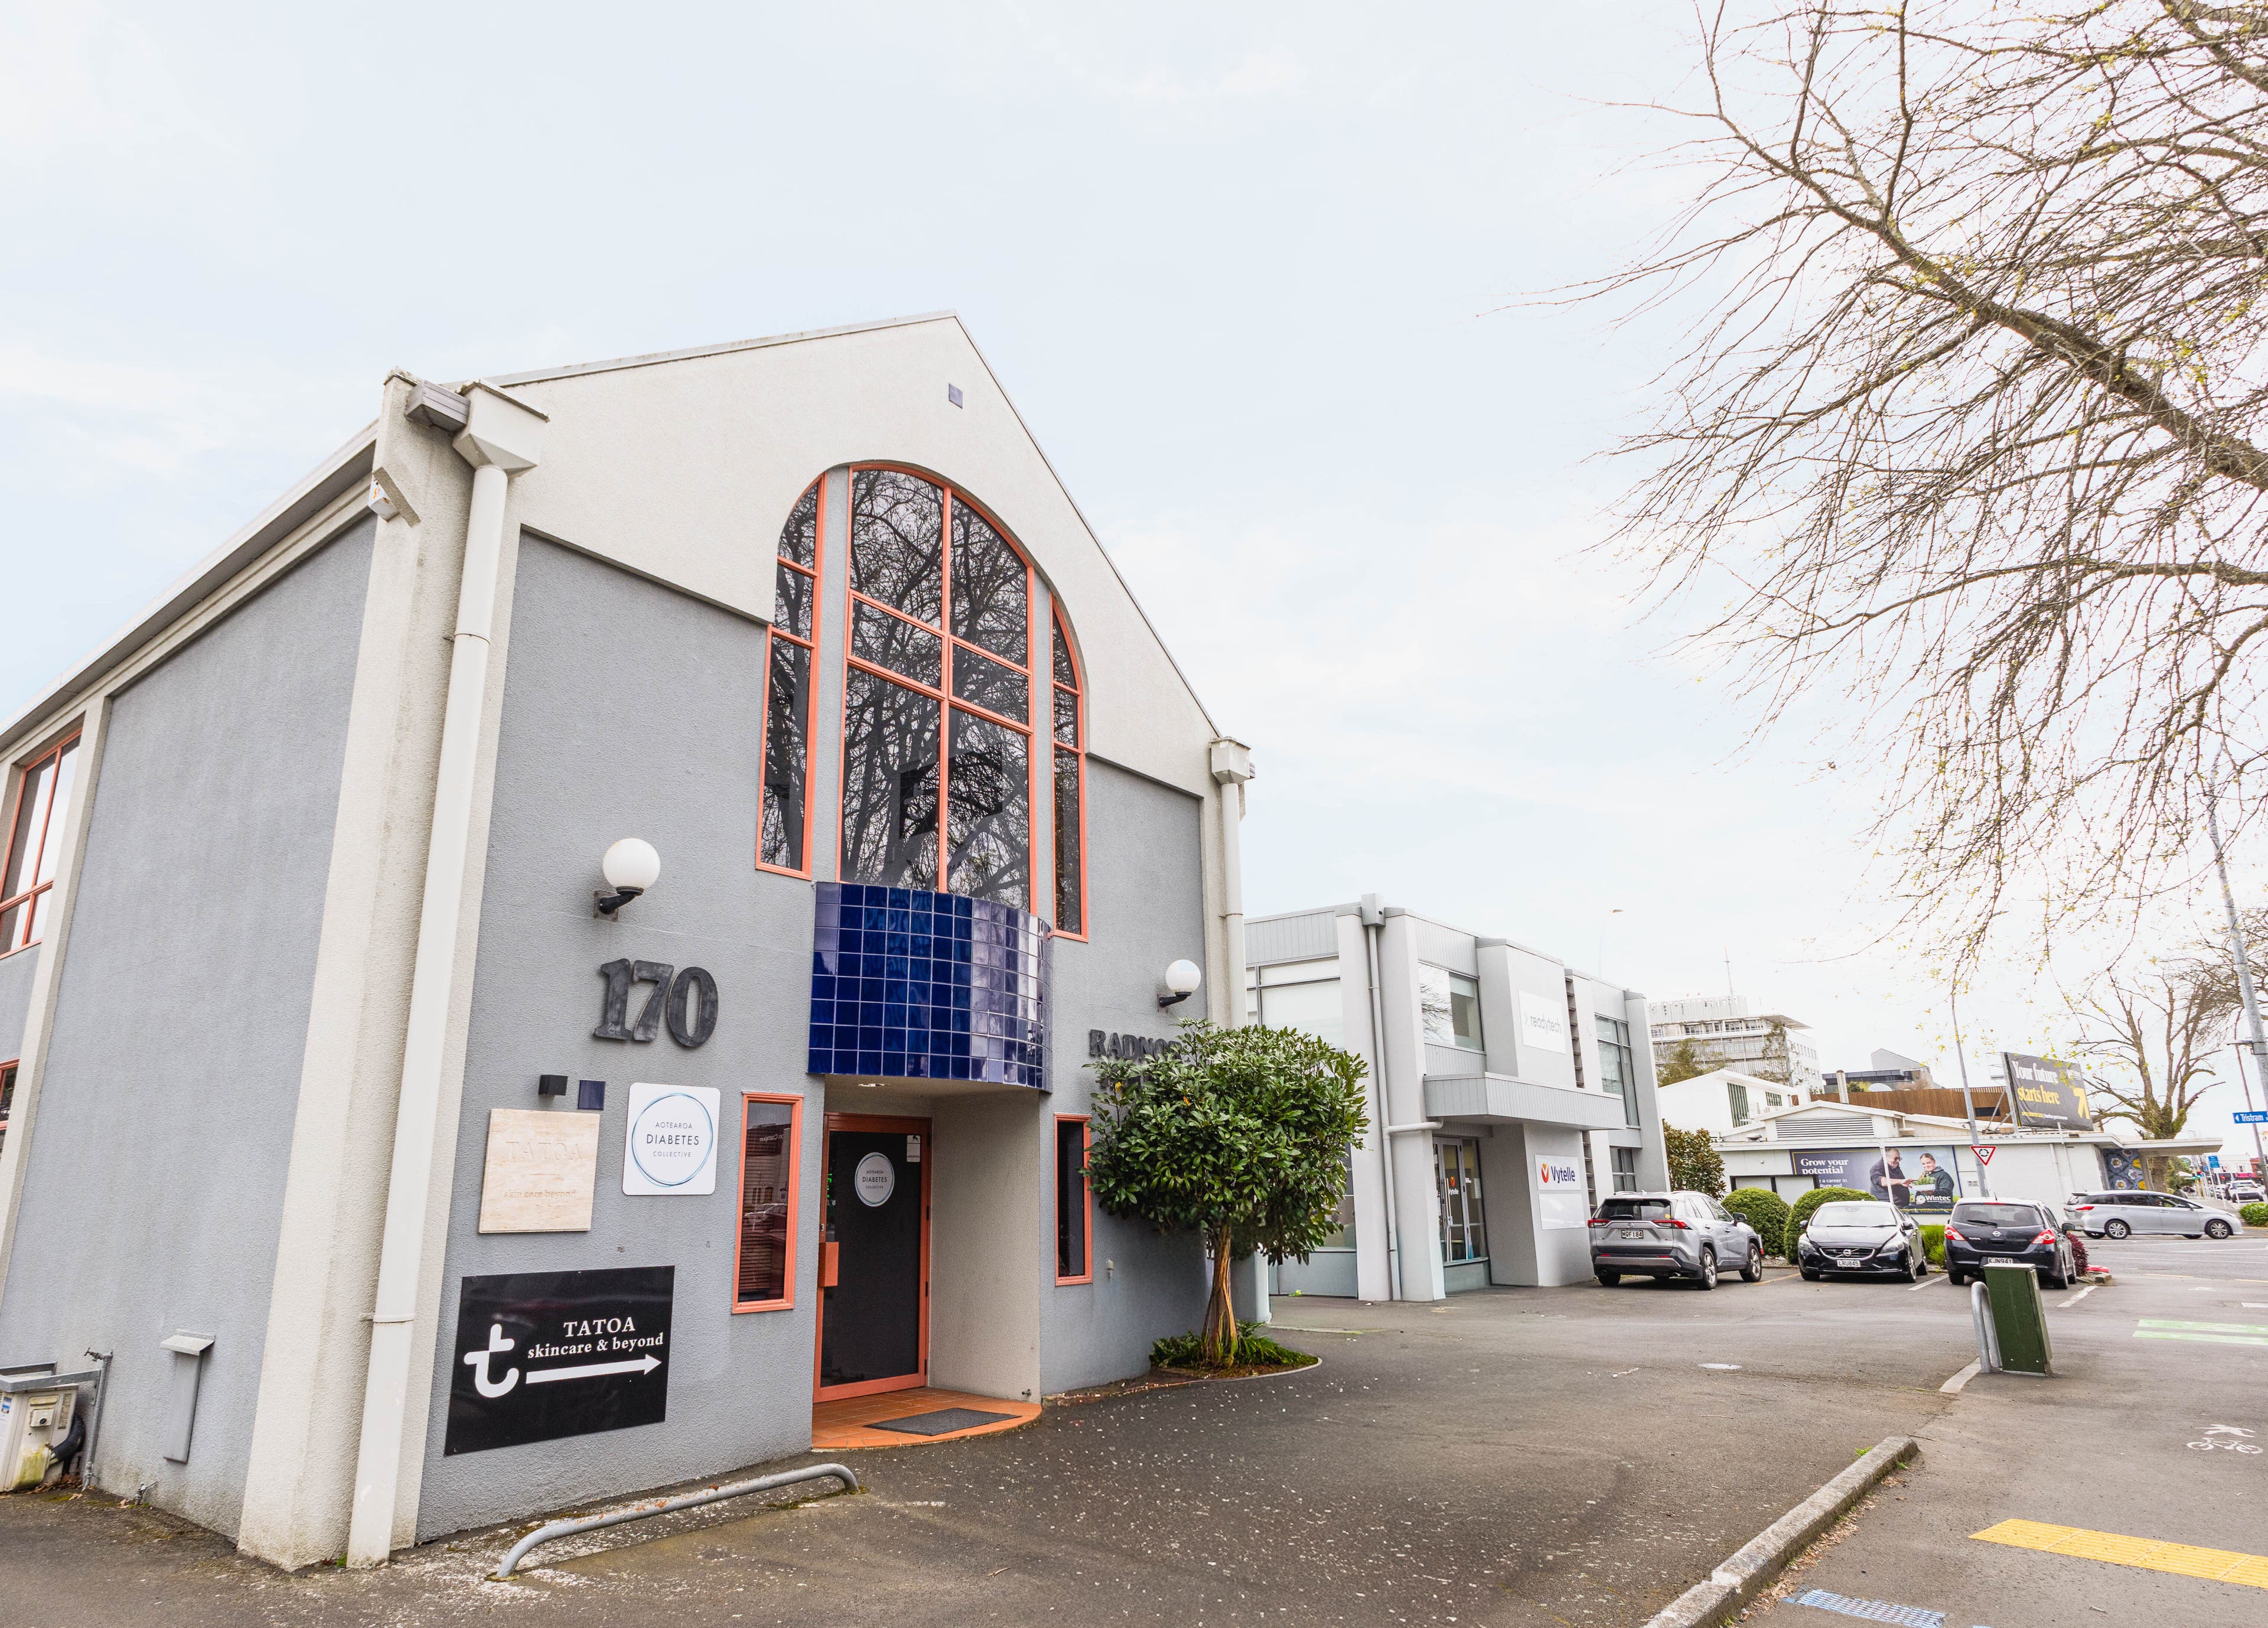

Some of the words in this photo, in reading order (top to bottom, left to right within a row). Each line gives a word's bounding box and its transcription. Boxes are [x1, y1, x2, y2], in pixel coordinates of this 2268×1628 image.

[594, 958, 718, 1047] 170
[1530, 1014, 1562, 1034] readytech
[2012, 1060, 2033, 1081] Your
[2033, 1063, 2059, 1084] future
[2017, 1086, 2042, 1103] starts
[2040, 1085, 2060, 1105] here
[2240, 1113, 2264, 1122] Tristram
[646, 1134, 699, 1145] DIABETES
[506, 1141, 582, 1160] TATOA
[1802, 1165, 1843, 1174] potential
[1827, 1159, 1849, 1168] your
[1551, 1166, 1575, 1183] Vytelle
[563, 1317, 636, 1337] TATOA
[527, 1343, 592, 1358] skincare
[597, 1339, 608, 1352] &
[612, 1332, 663, 1352] beyond
